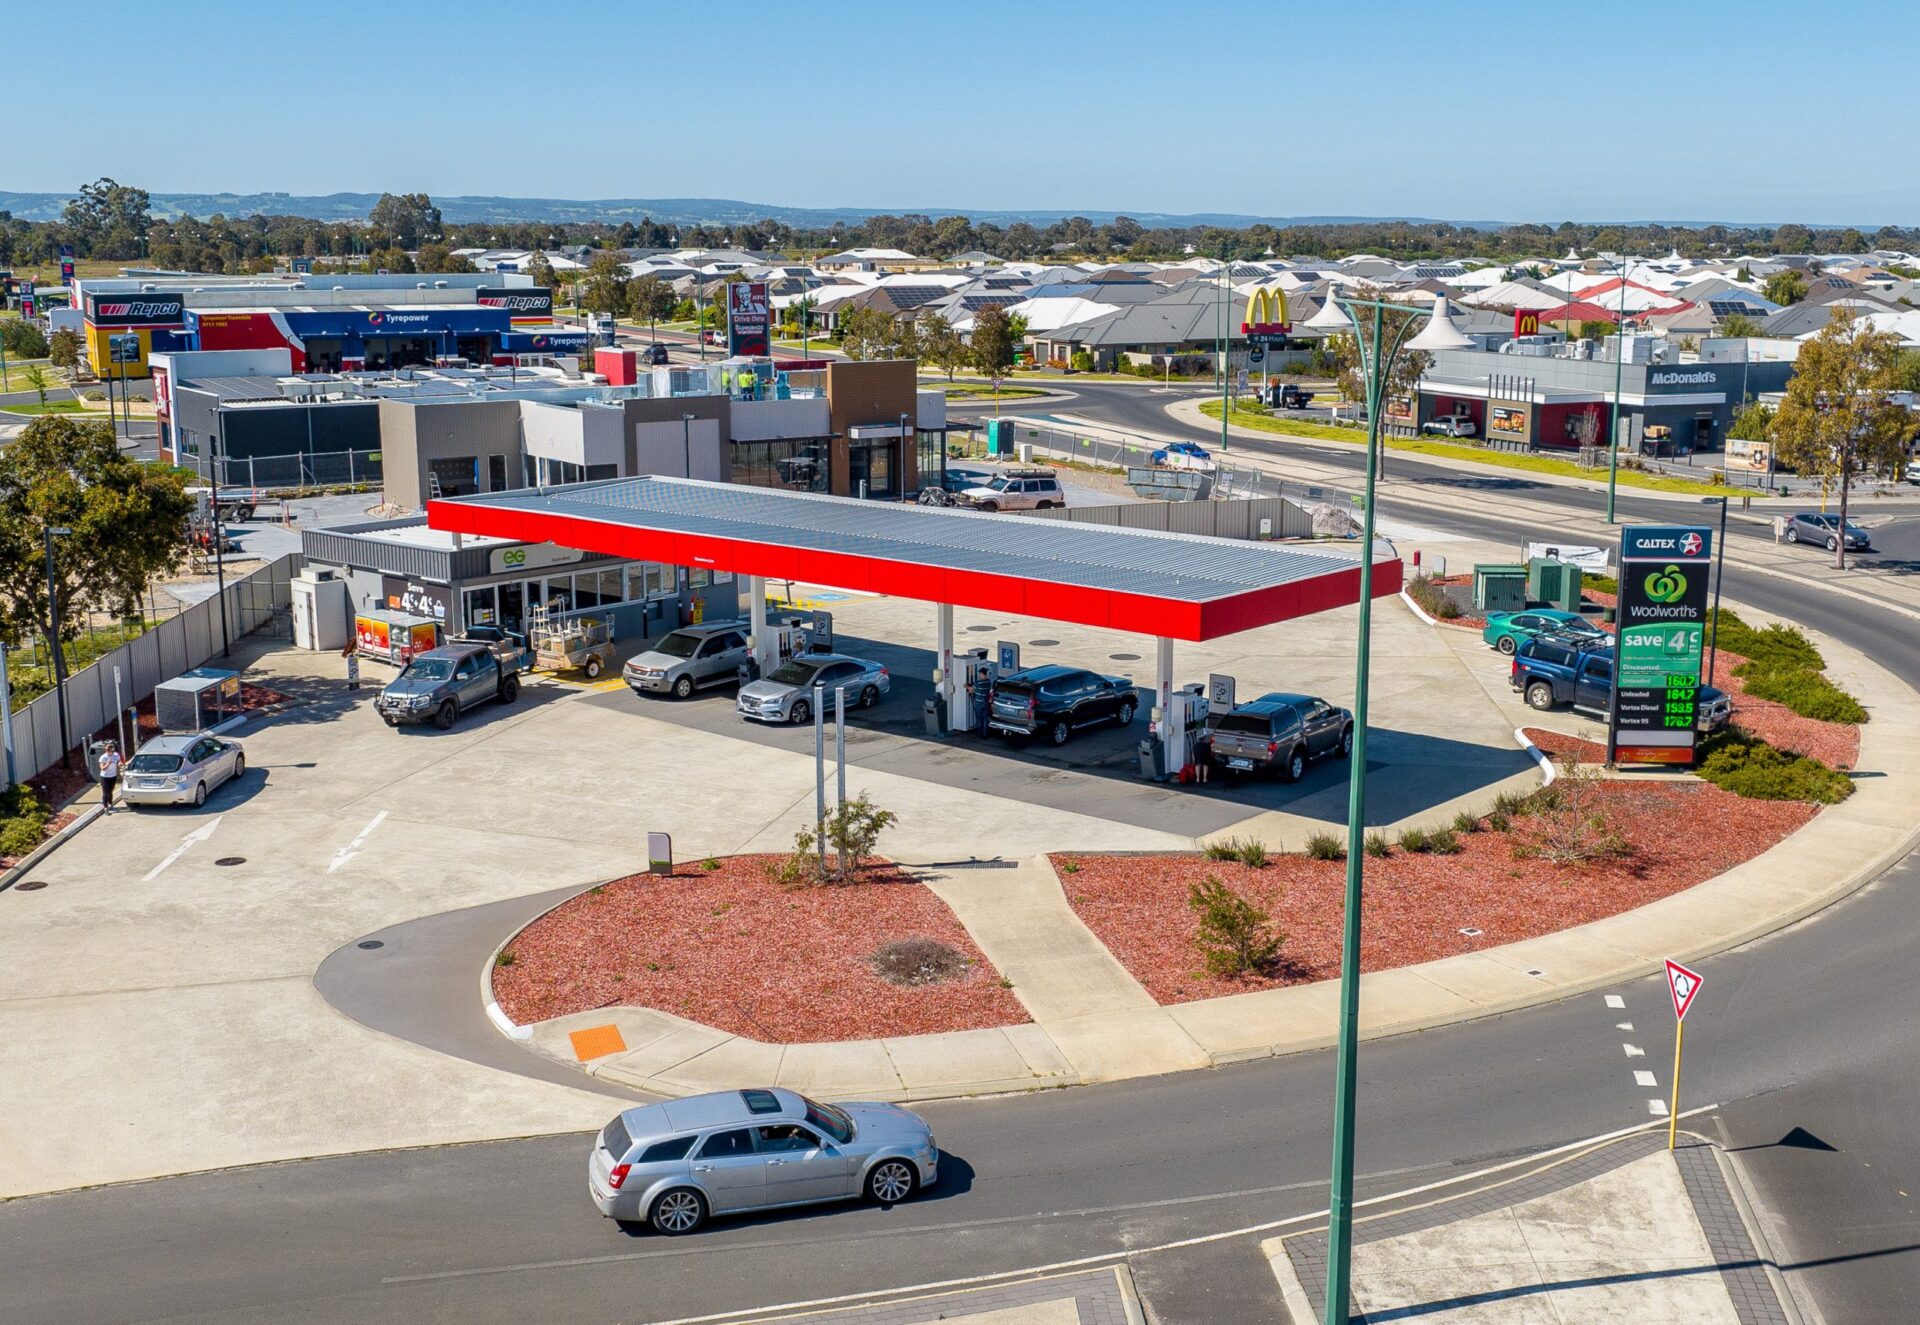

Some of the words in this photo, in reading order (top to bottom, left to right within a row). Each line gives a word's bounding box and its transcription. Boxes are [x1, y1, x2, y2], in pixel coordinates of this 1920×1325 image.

[505, 296, 550, 311] Repco
[130, 302, 180, 317] Repco
[385, 314, 429, 324] Tyrepower
[549, 337, 590, 347] Tyrepowe
[1652, 372, 1716, 384] McDonald's
[1636, 539, 1676, 549] CALTEX
[408, 582, 424, 594] Save
[1631, 604, 1698, 618] Woolworths
[1624, 634, 1663, 647] save
[1620, 690, 1650, 698] Unleaded
[1620, 703, 1640, 711] Vortex
[1640, 703, 1660, 711] Diesel
[1620, 717, 1638, 725] Vortex
